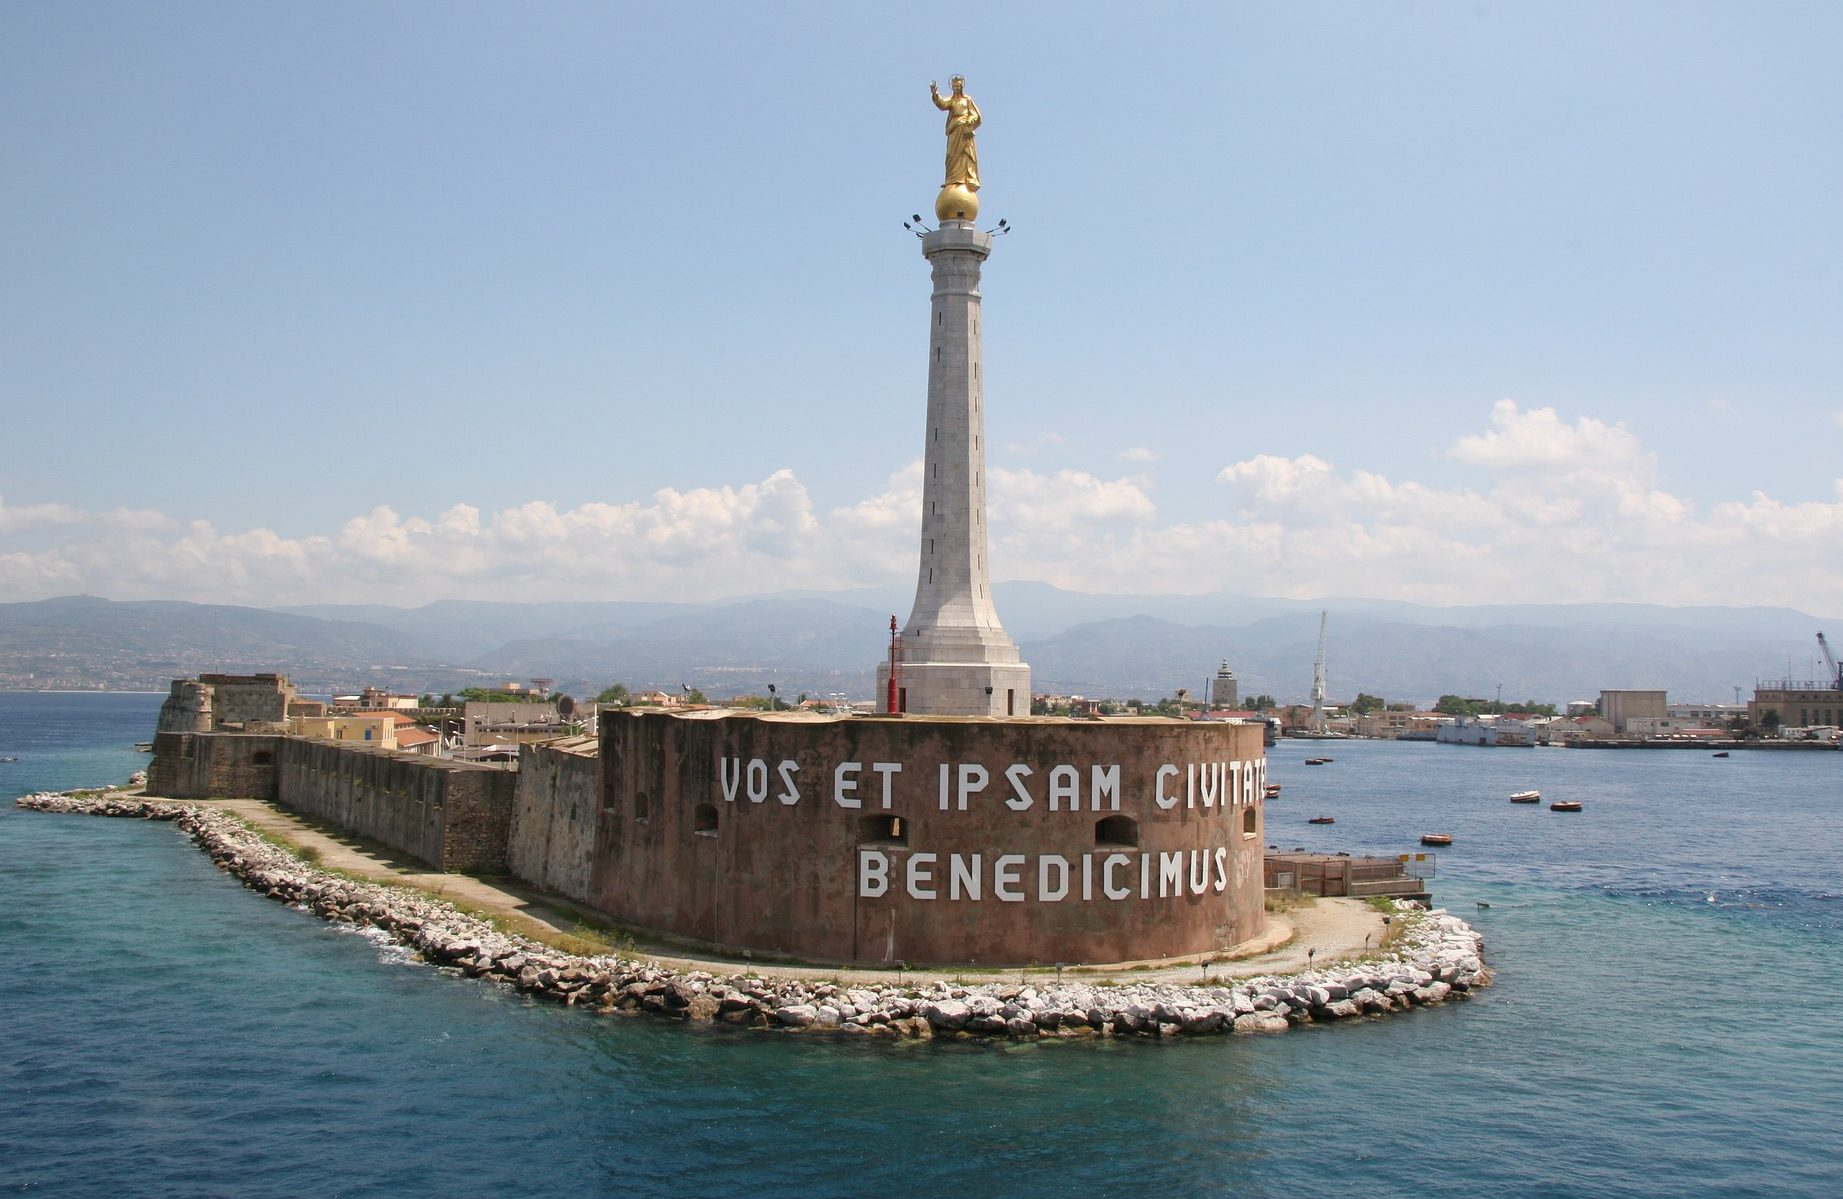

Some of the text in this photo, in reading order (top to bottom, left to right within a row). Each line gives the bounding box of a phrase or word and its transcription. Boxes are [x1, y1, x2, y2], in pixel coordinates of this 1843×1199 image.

[720, 757, 800, 806] VOS
[834, 762, 902, 809] ET
[939, 763, 1121, 812] IPSAM
[860, 847, 1227, 902] BENEDICIMUS
